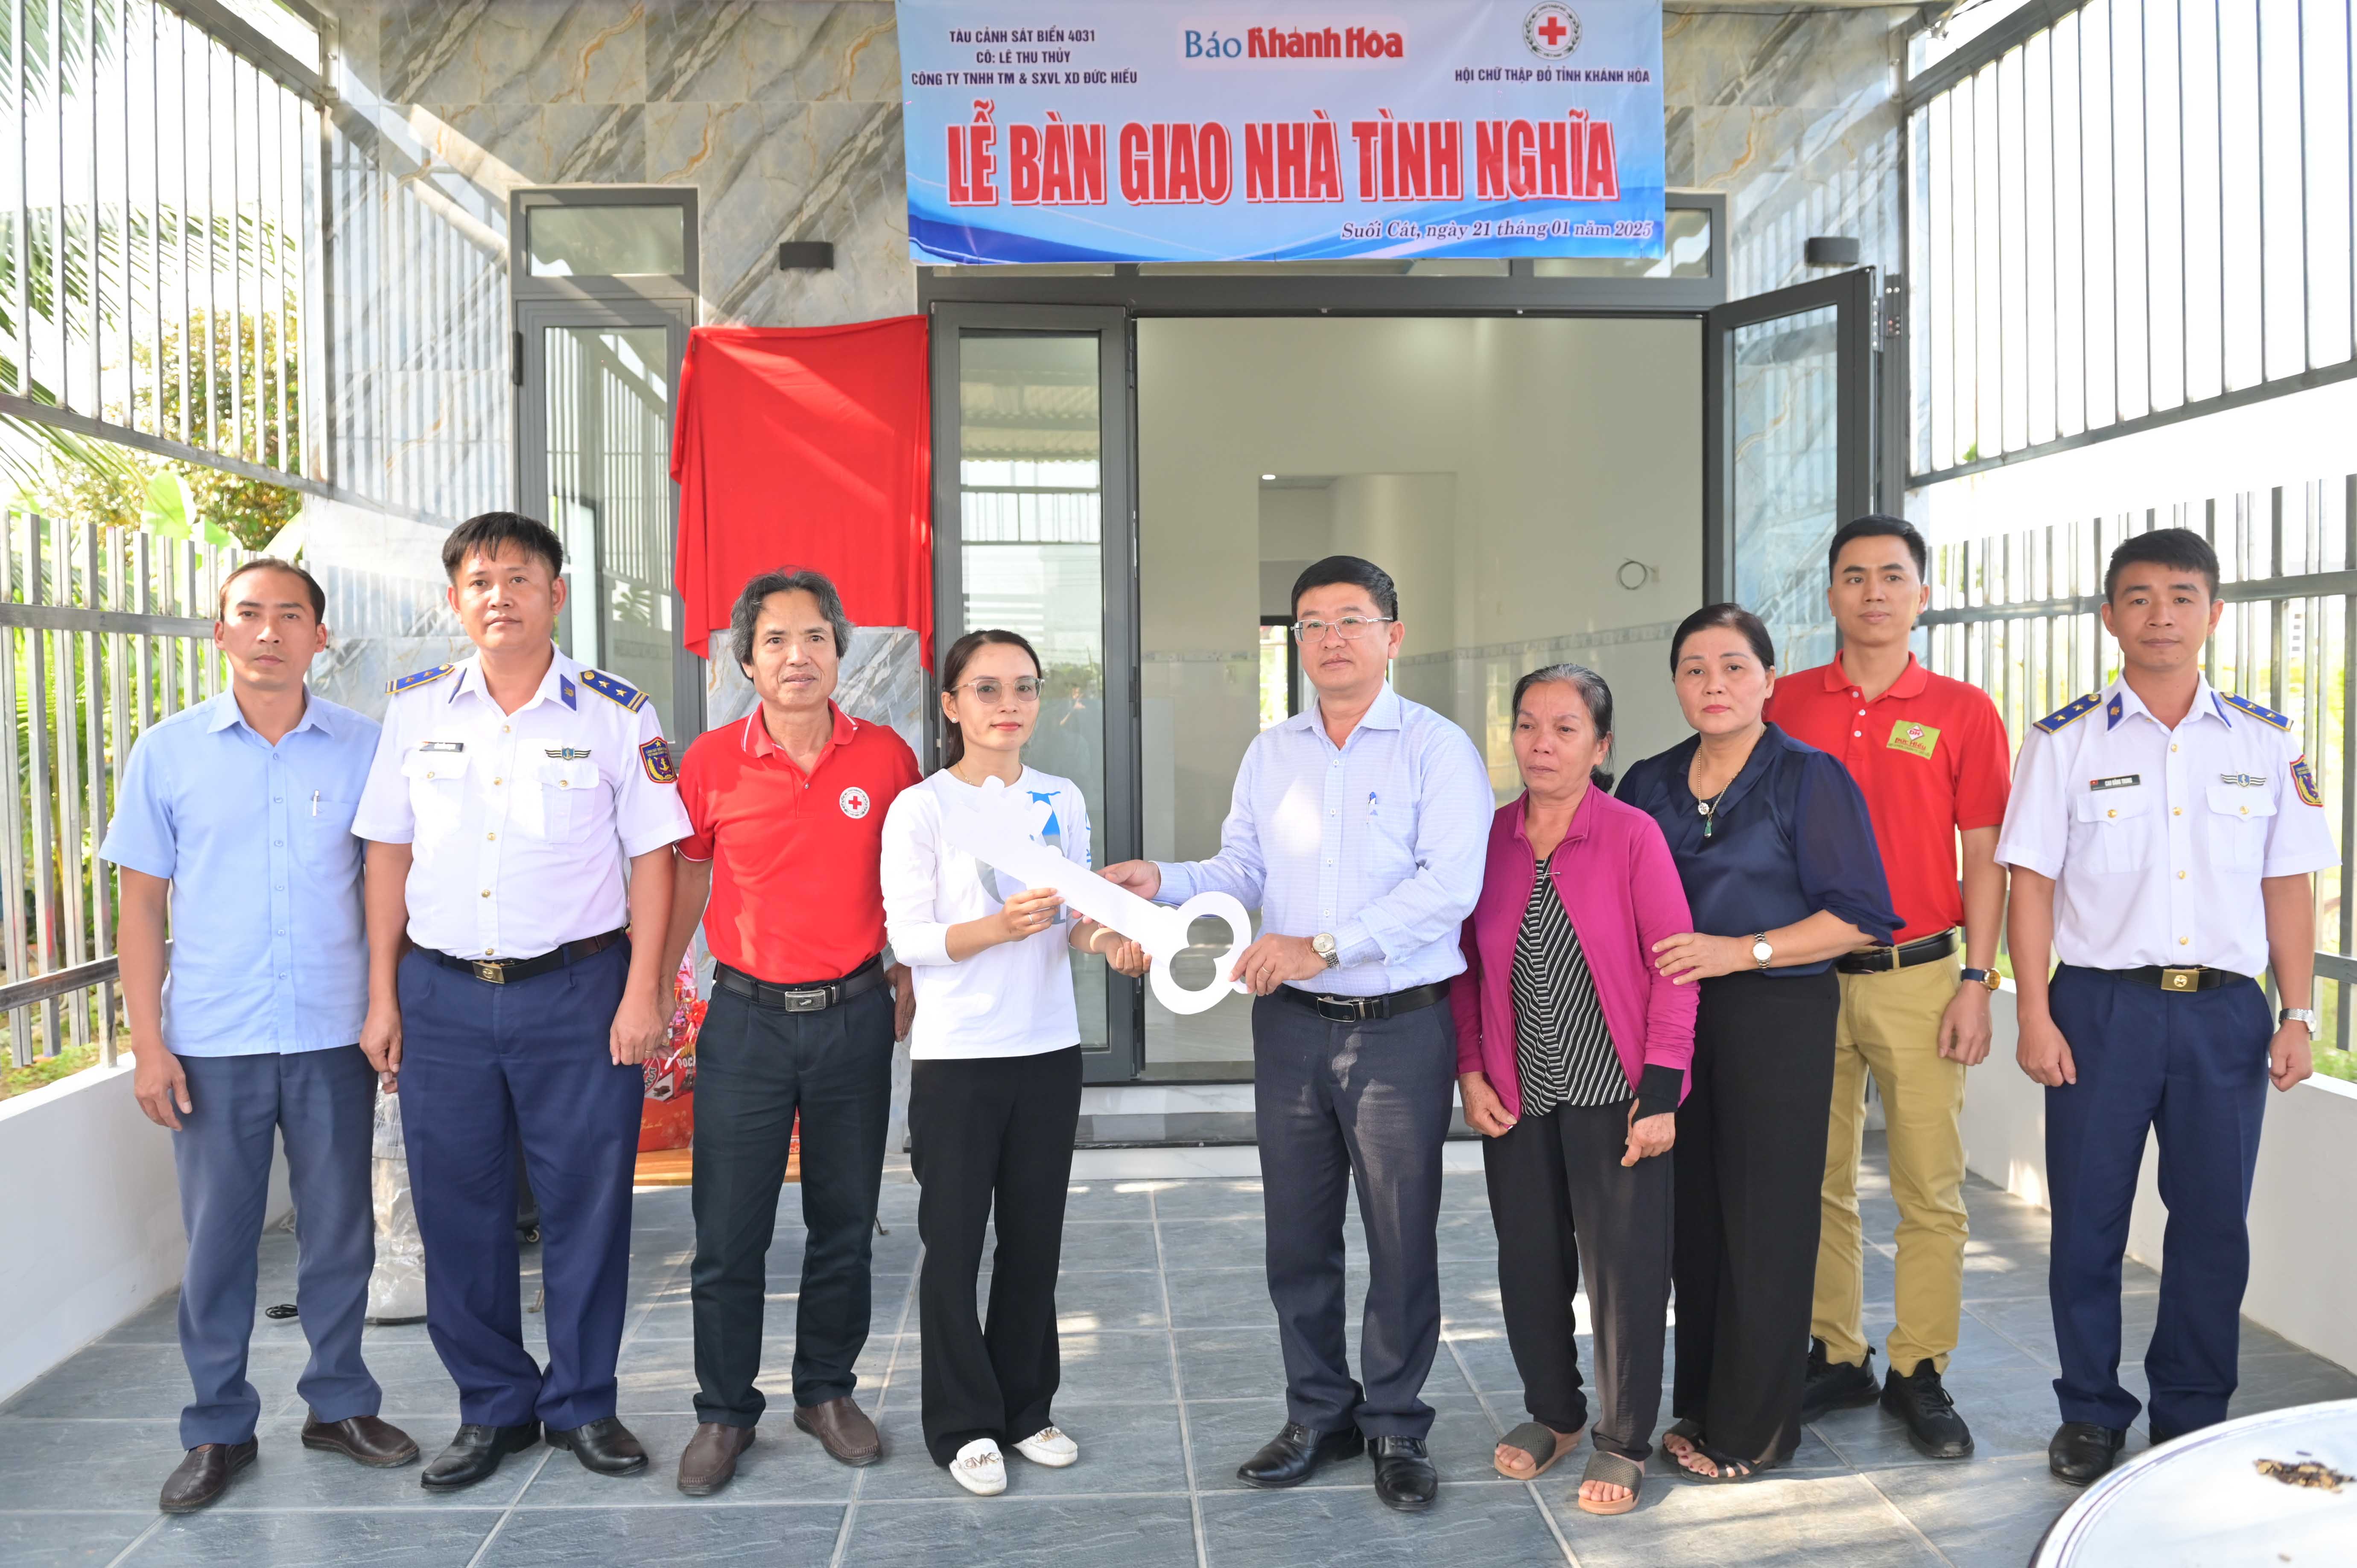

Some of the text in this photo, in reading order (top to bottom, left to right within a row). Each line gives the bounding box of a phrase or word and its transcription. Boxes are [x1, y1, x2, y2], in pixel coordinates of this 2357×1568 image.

[949, 25, 1095, 43] TÀU CẢNH SÁT BIỂN 4031
[1185, 30, 1242, 58] Báo
[976, 47, 1071, 63] CÔ: LÊ THU THỦY
[911, 67, 1137, 85] CÔNG TY TNHH TM & SXVL XD ĐỨC HIẾU
[1455, 65, 1650, 84] HỘI CHỮ THẬP ĐỎ TỈNH KHÁNH HÒA
[946, 99, 1621, 206] LỄ BÀN GIAO NHÀ TÌNH NGHĨA
[1341, 219, 1653, 240] Suối Cát, ngày 21 tháng 01 năm 2025
